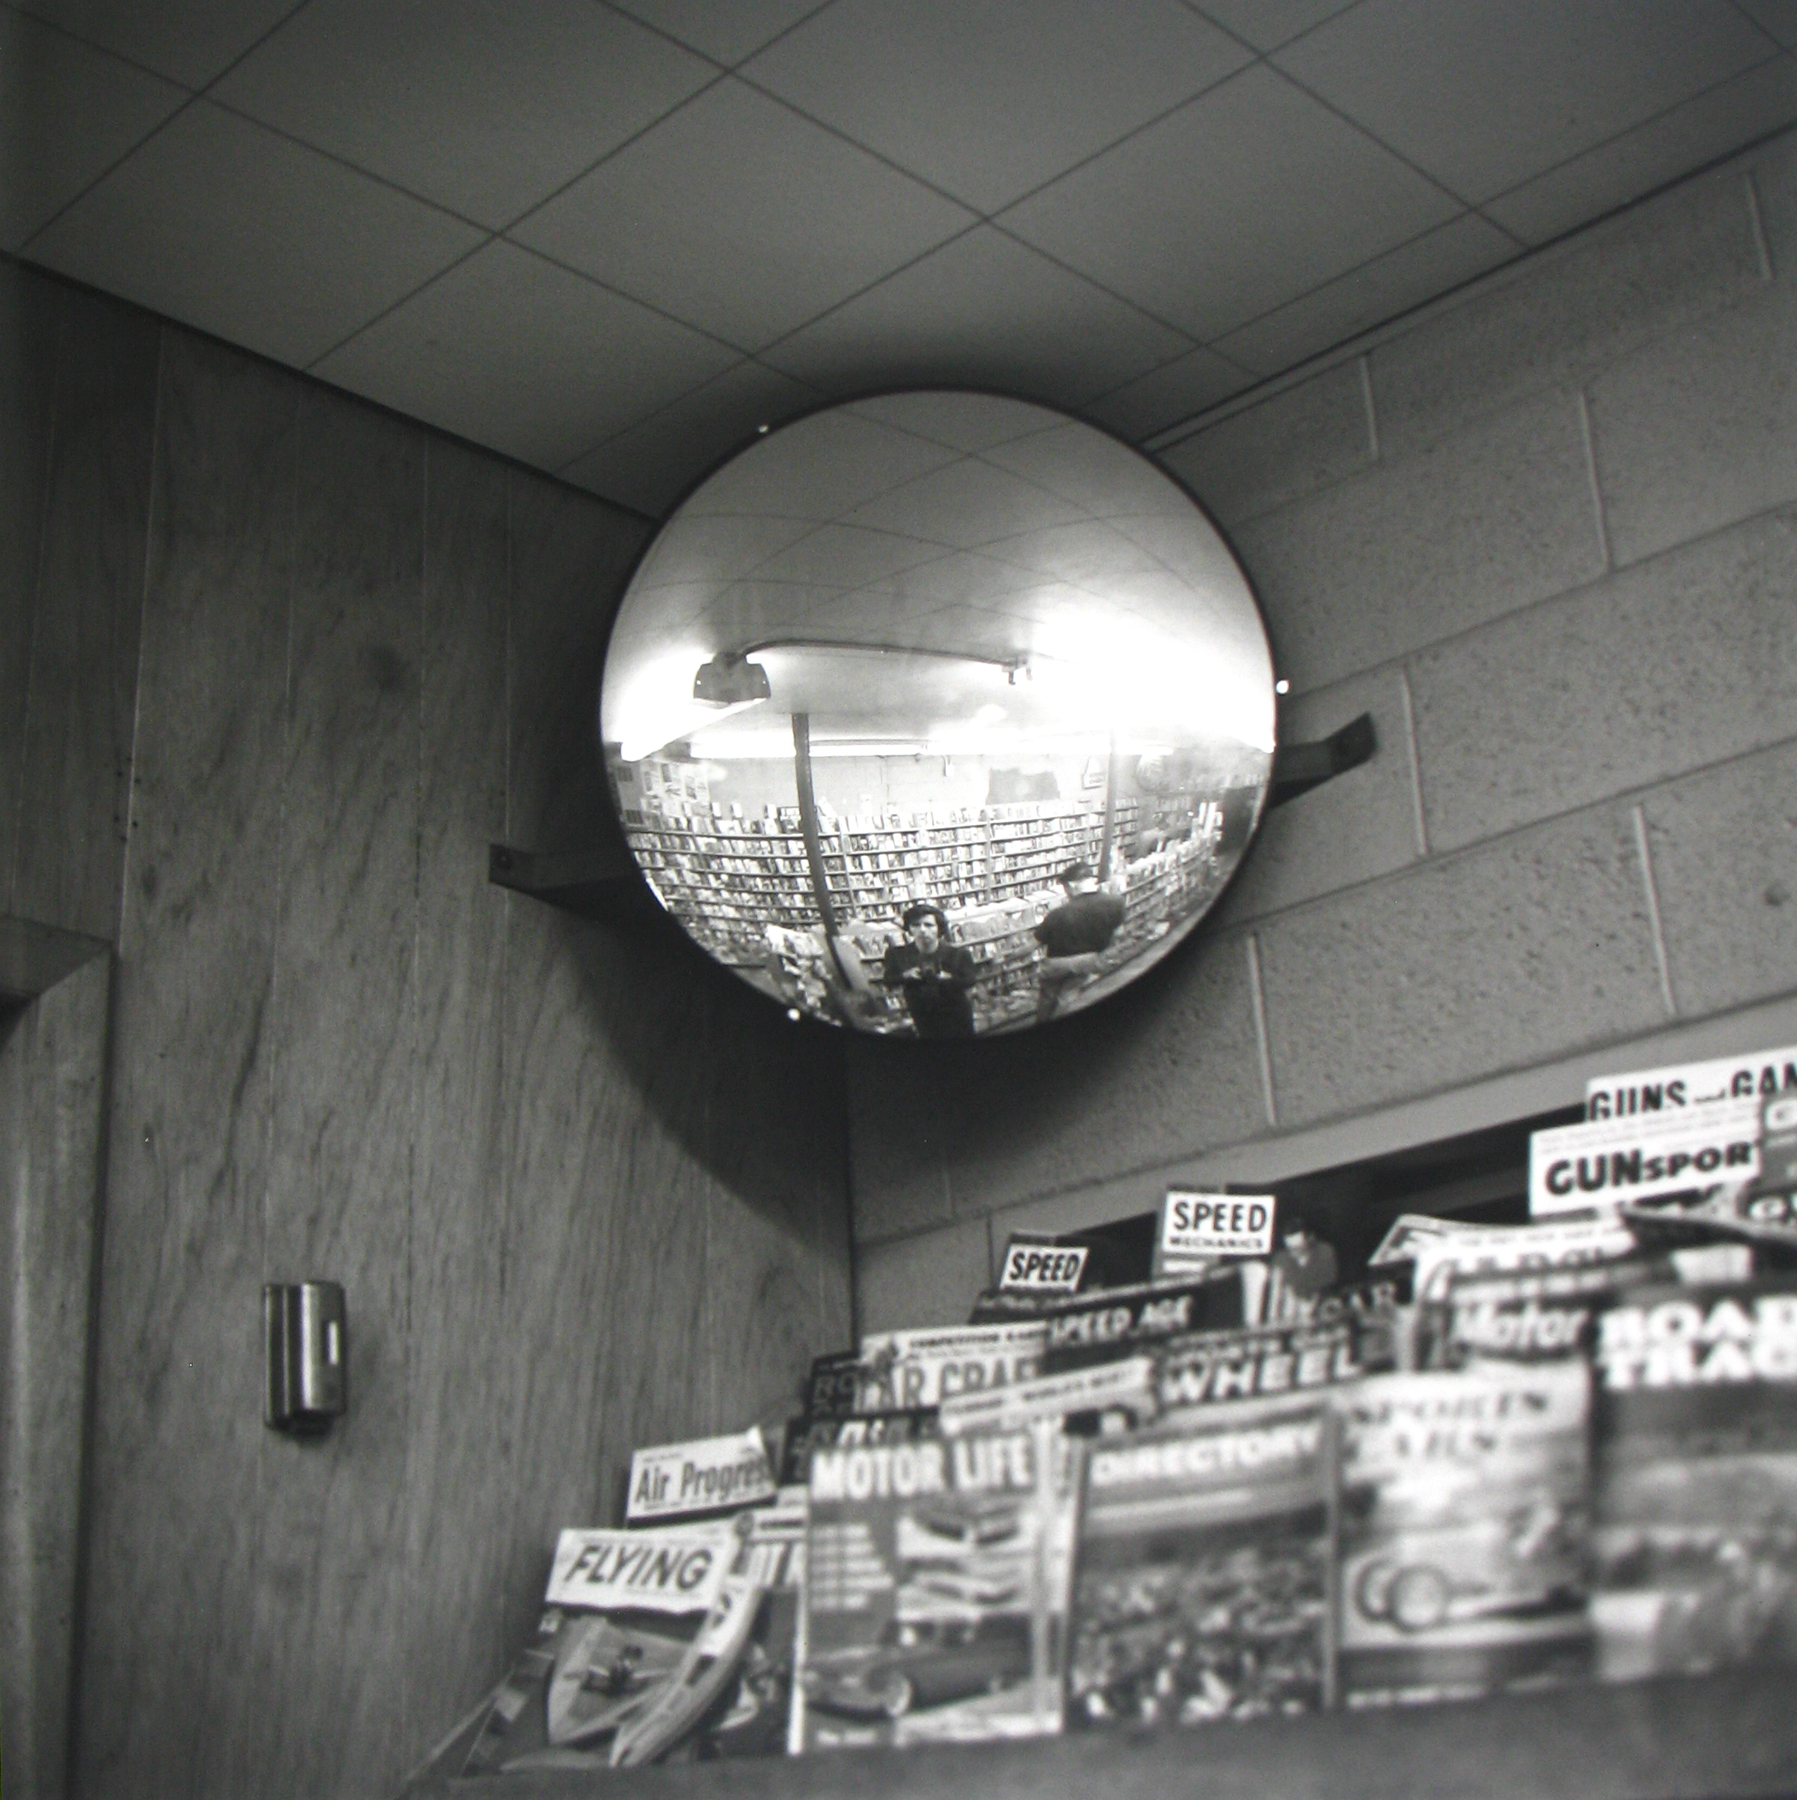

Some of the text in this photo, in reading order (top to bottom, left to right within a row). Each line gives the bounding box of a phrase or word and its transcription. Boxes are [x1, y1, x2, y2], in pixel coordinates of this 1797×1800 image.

[1545, 1141, 1764, 1196] GUNSPOR
[1172, 1201, 1268, 1233] SPEED
[1009, 1252, 1080, 1282] SPEED
[635, 1464, 670, 1504] Air
[808, 1438, 946, 1502] MOTOR
[951, 1430, 1034, 1492] LIFE
[563, 1545, 713, 1590] FLYING
